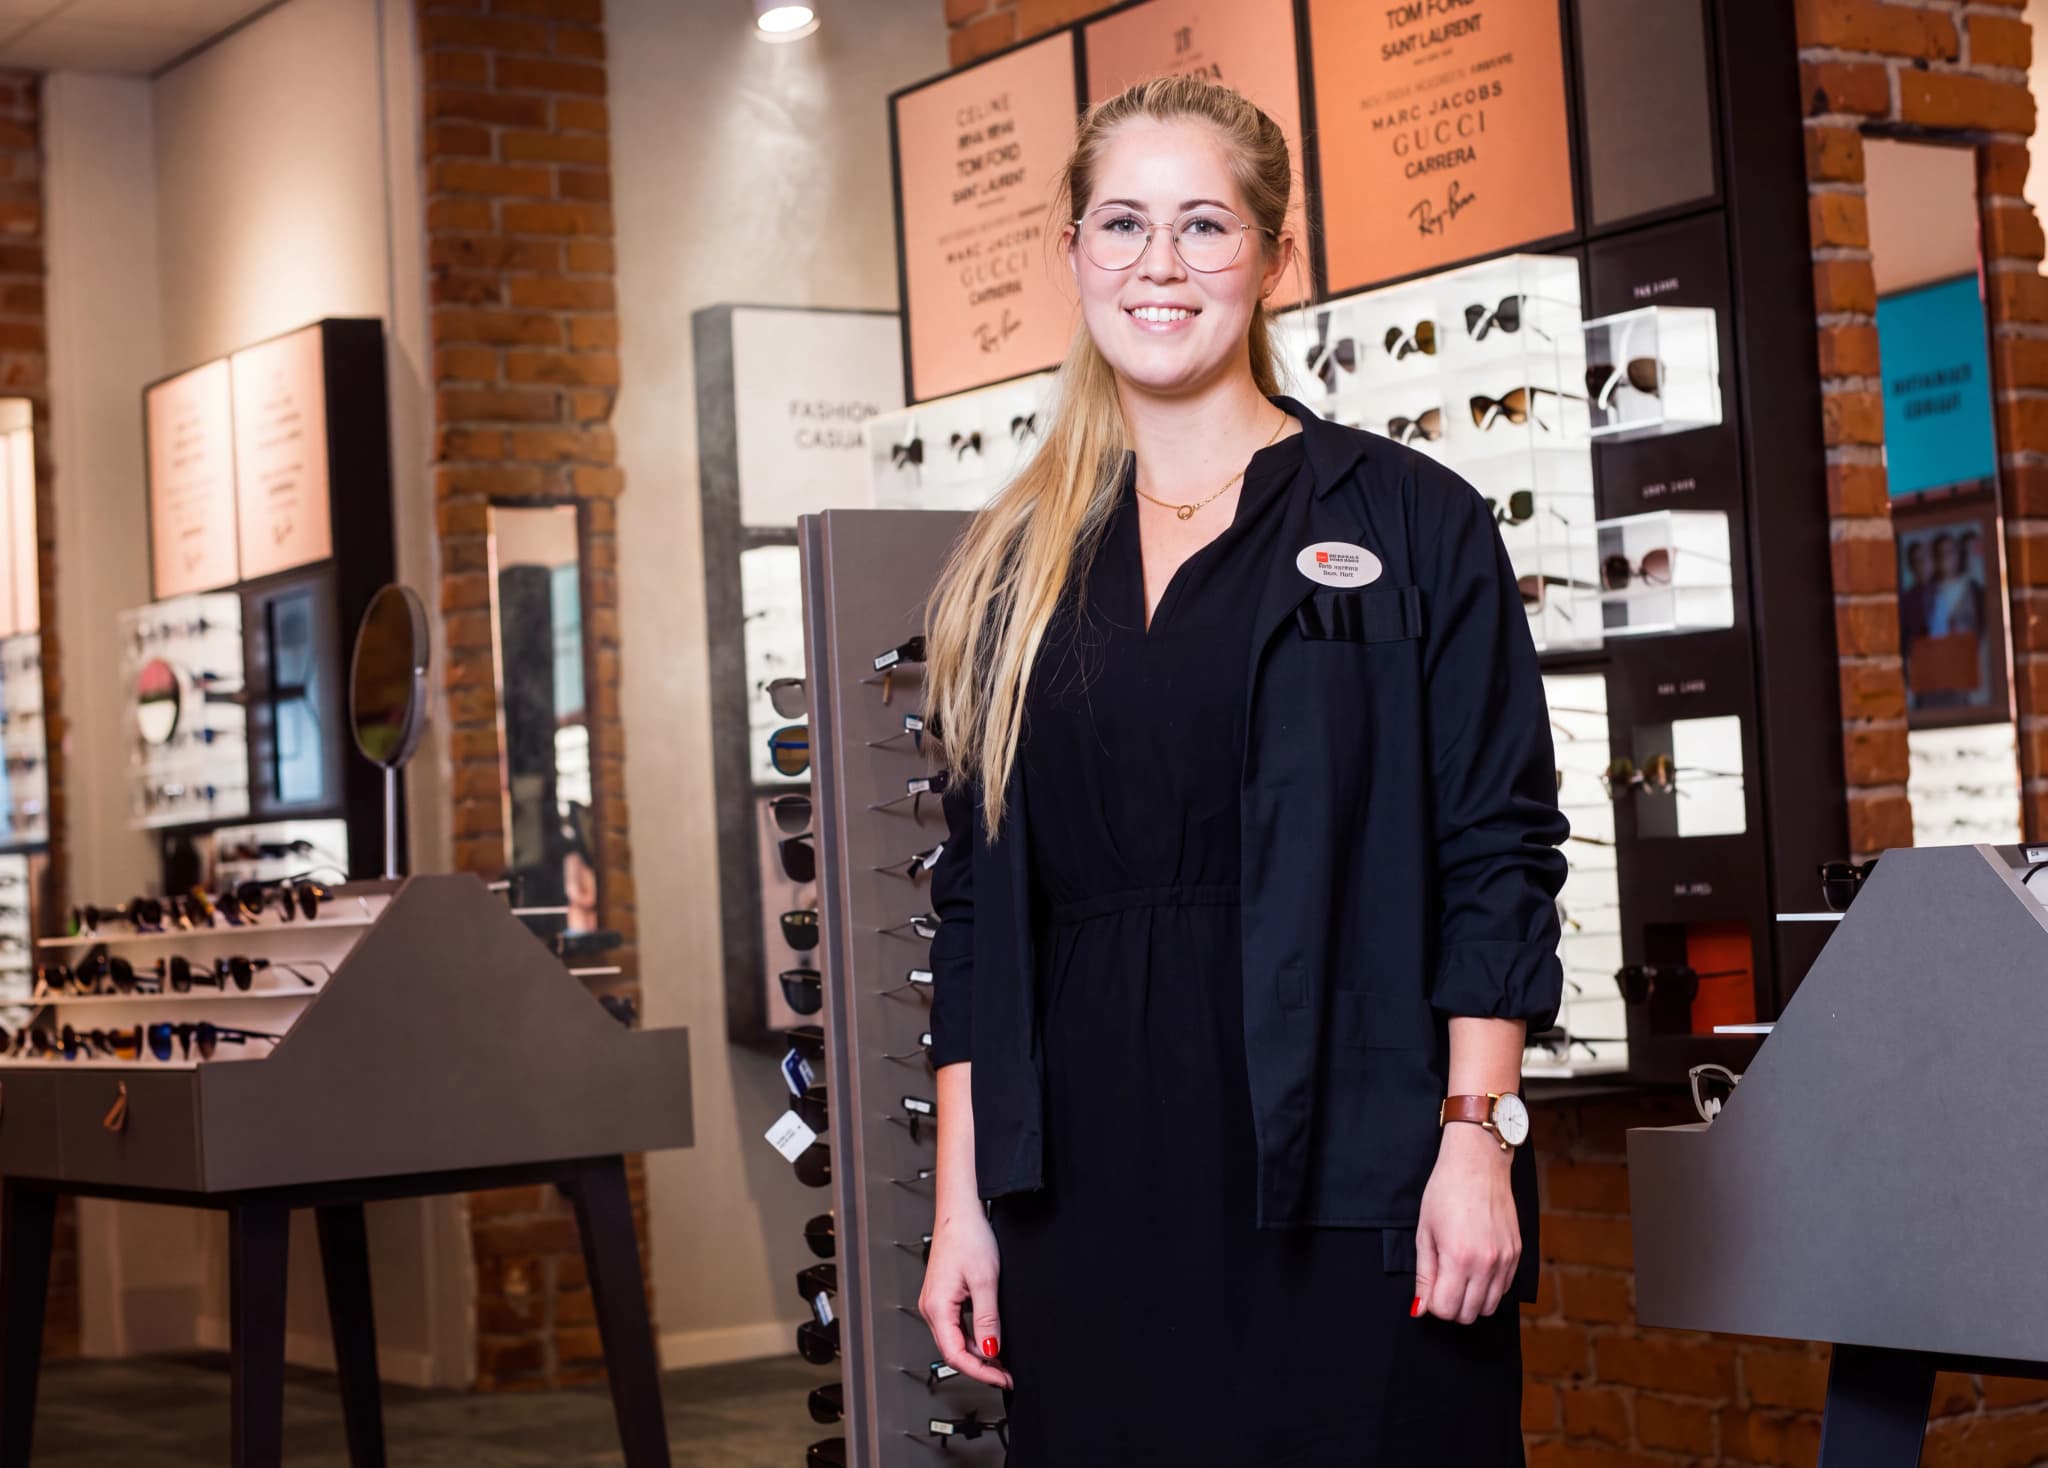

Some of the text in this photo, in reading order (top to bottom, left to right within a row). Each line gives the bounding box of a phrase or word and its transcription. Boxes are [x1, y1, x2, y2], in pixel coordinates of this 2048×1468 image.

[1382, 34, 1416, 62] SAINT
[1420, 13, 1482, 48] LAURENT
[1386, 1, 1422, 30] TOM
[1372, 105, 1421, 131] MARC
[1429, 80, 1503, 116] JACOBS
[1392, 110, 1485, 157] GUCCI
[1405, 146, 1476, 179] CARRERA
